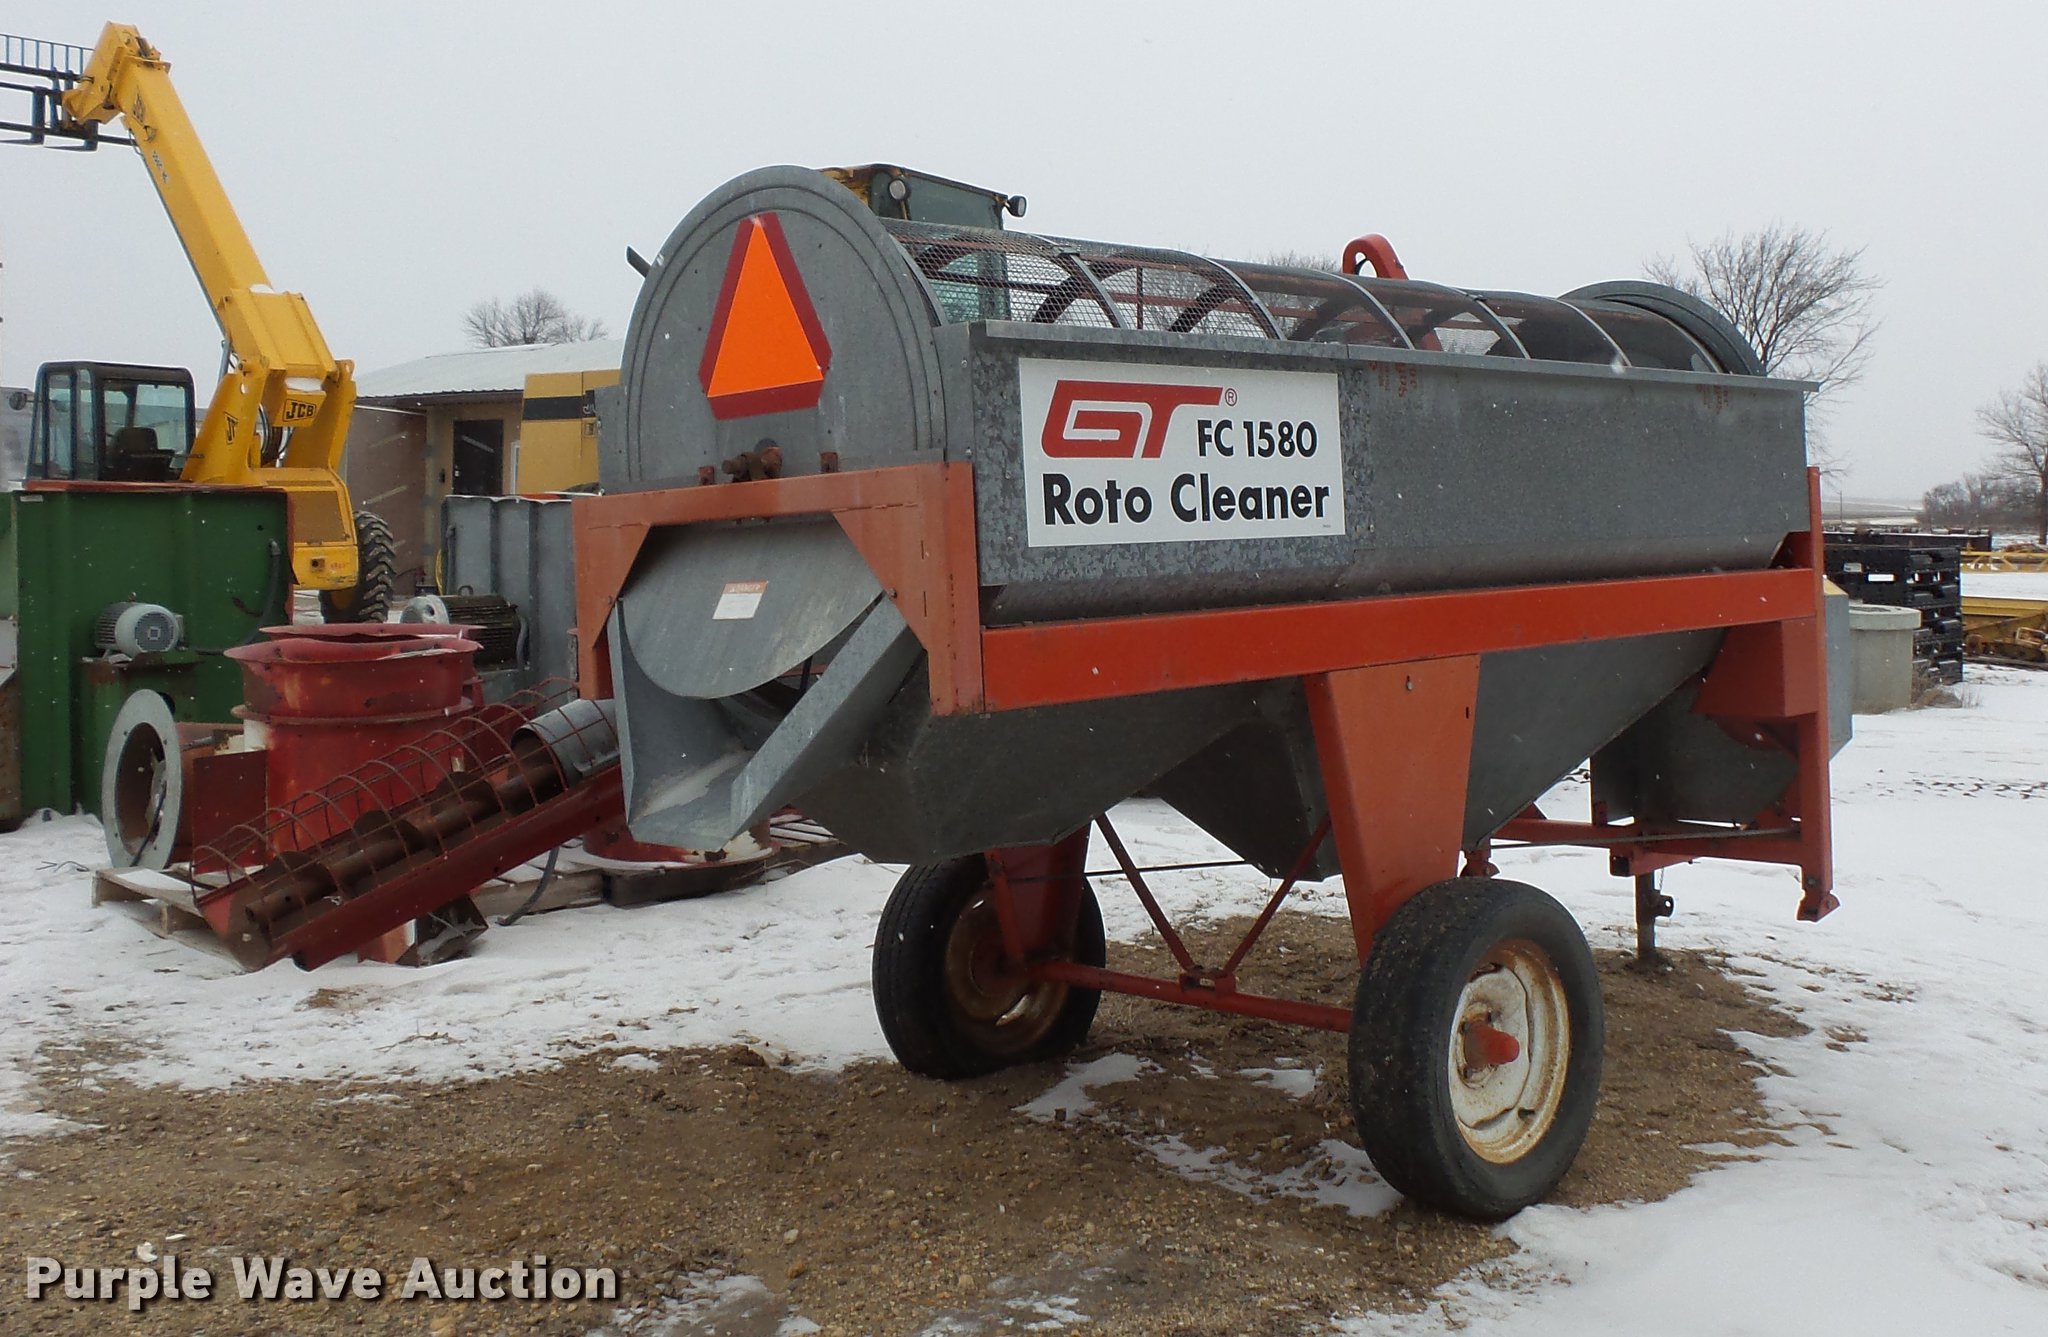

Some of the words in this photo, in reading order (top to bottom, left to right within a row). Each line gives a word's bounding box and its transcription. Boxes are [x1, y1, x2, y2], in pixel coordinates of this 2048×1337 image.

[286, 402, 315, 420] JCB
[1041, 380, 1223, 459] GT
[1197, 419, 1234, 457] FC
[1243, 420, 1318, 458] 1580
[1042, 473, 1153, 525] Roto
[1170, 473, 1330, 523] Cleaner
